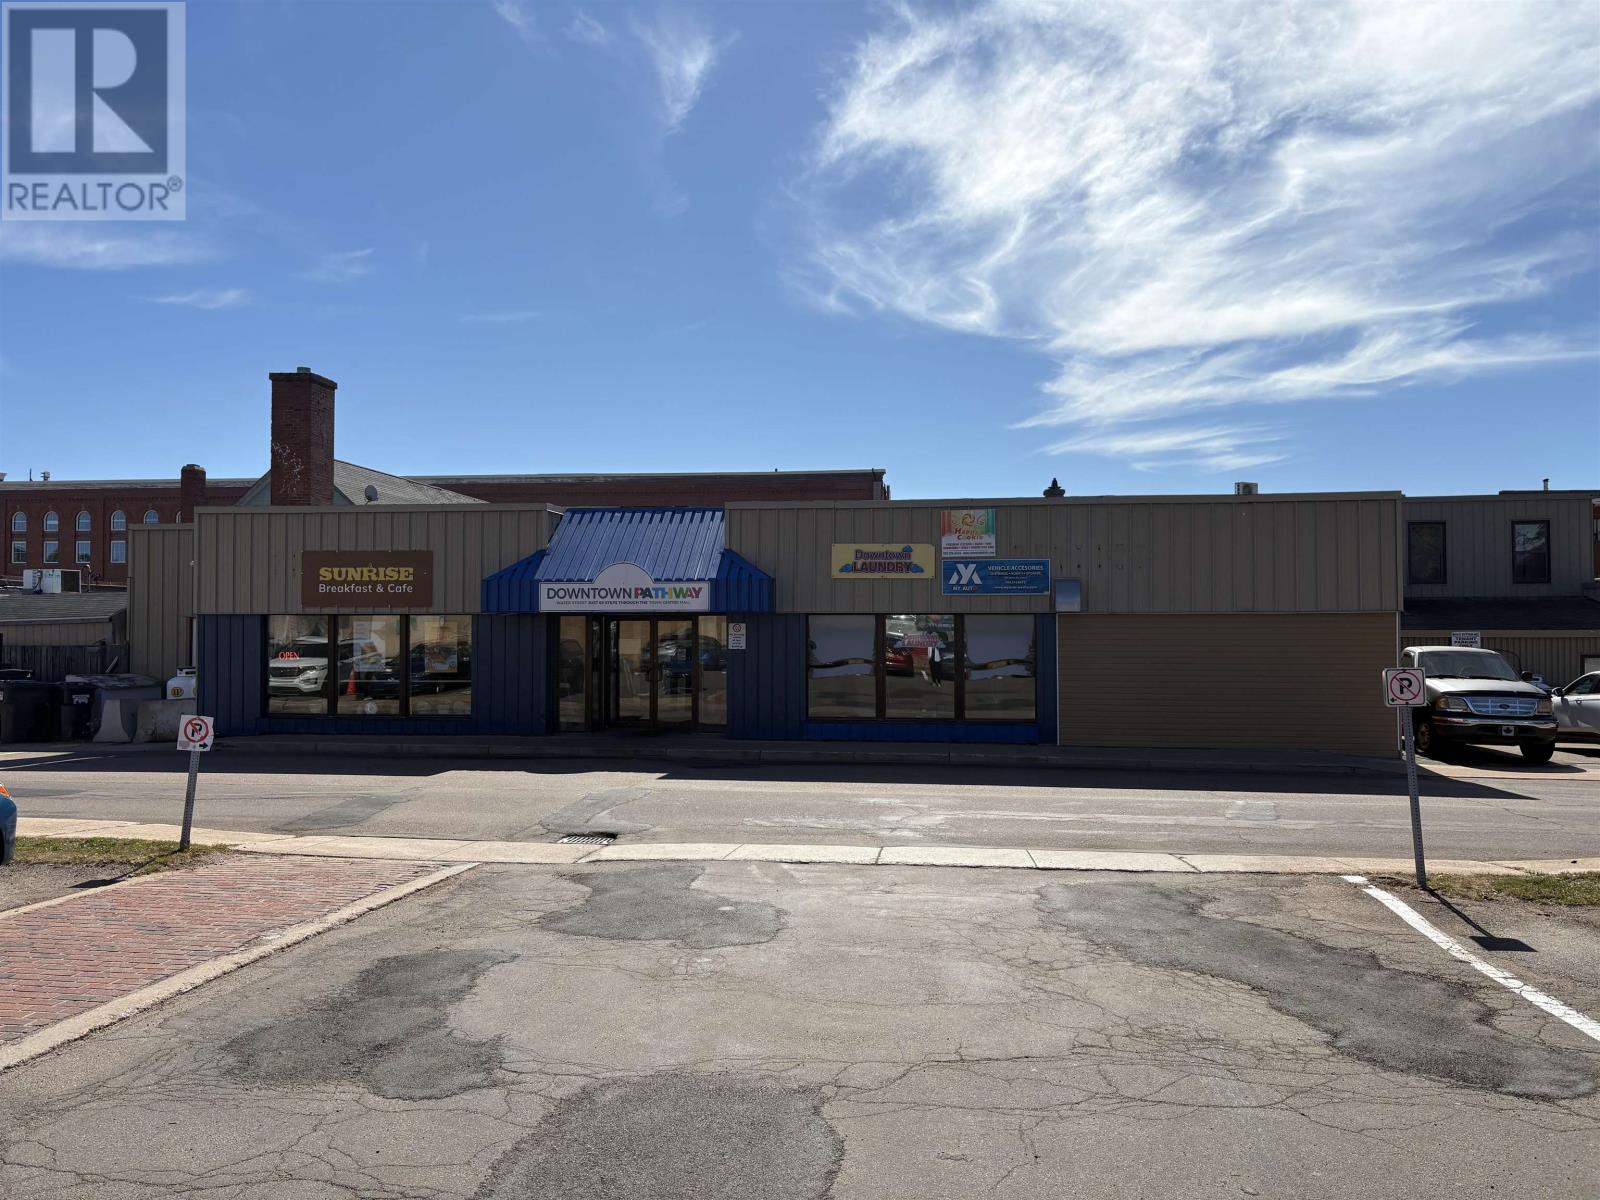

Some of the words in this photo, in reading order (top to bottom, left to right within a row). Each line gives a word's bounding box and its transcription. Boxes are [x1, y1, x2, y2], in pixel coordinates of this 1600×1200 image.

[855, 548, 912, 561] Downtown
[319, 566, 414, 581] SUNRISE
[853, 561, 912, 574] LAUNDRY
[319, 584, 373, 593] Breakfast
[376, 584, 385, 593] &
[387, 584, 413, 593] Cafe
[547, 587, 632, 599] DOWNTOWN
[634, 587, 703, 599] PATHWAY
[279, 651, 300, 661] OPEN
